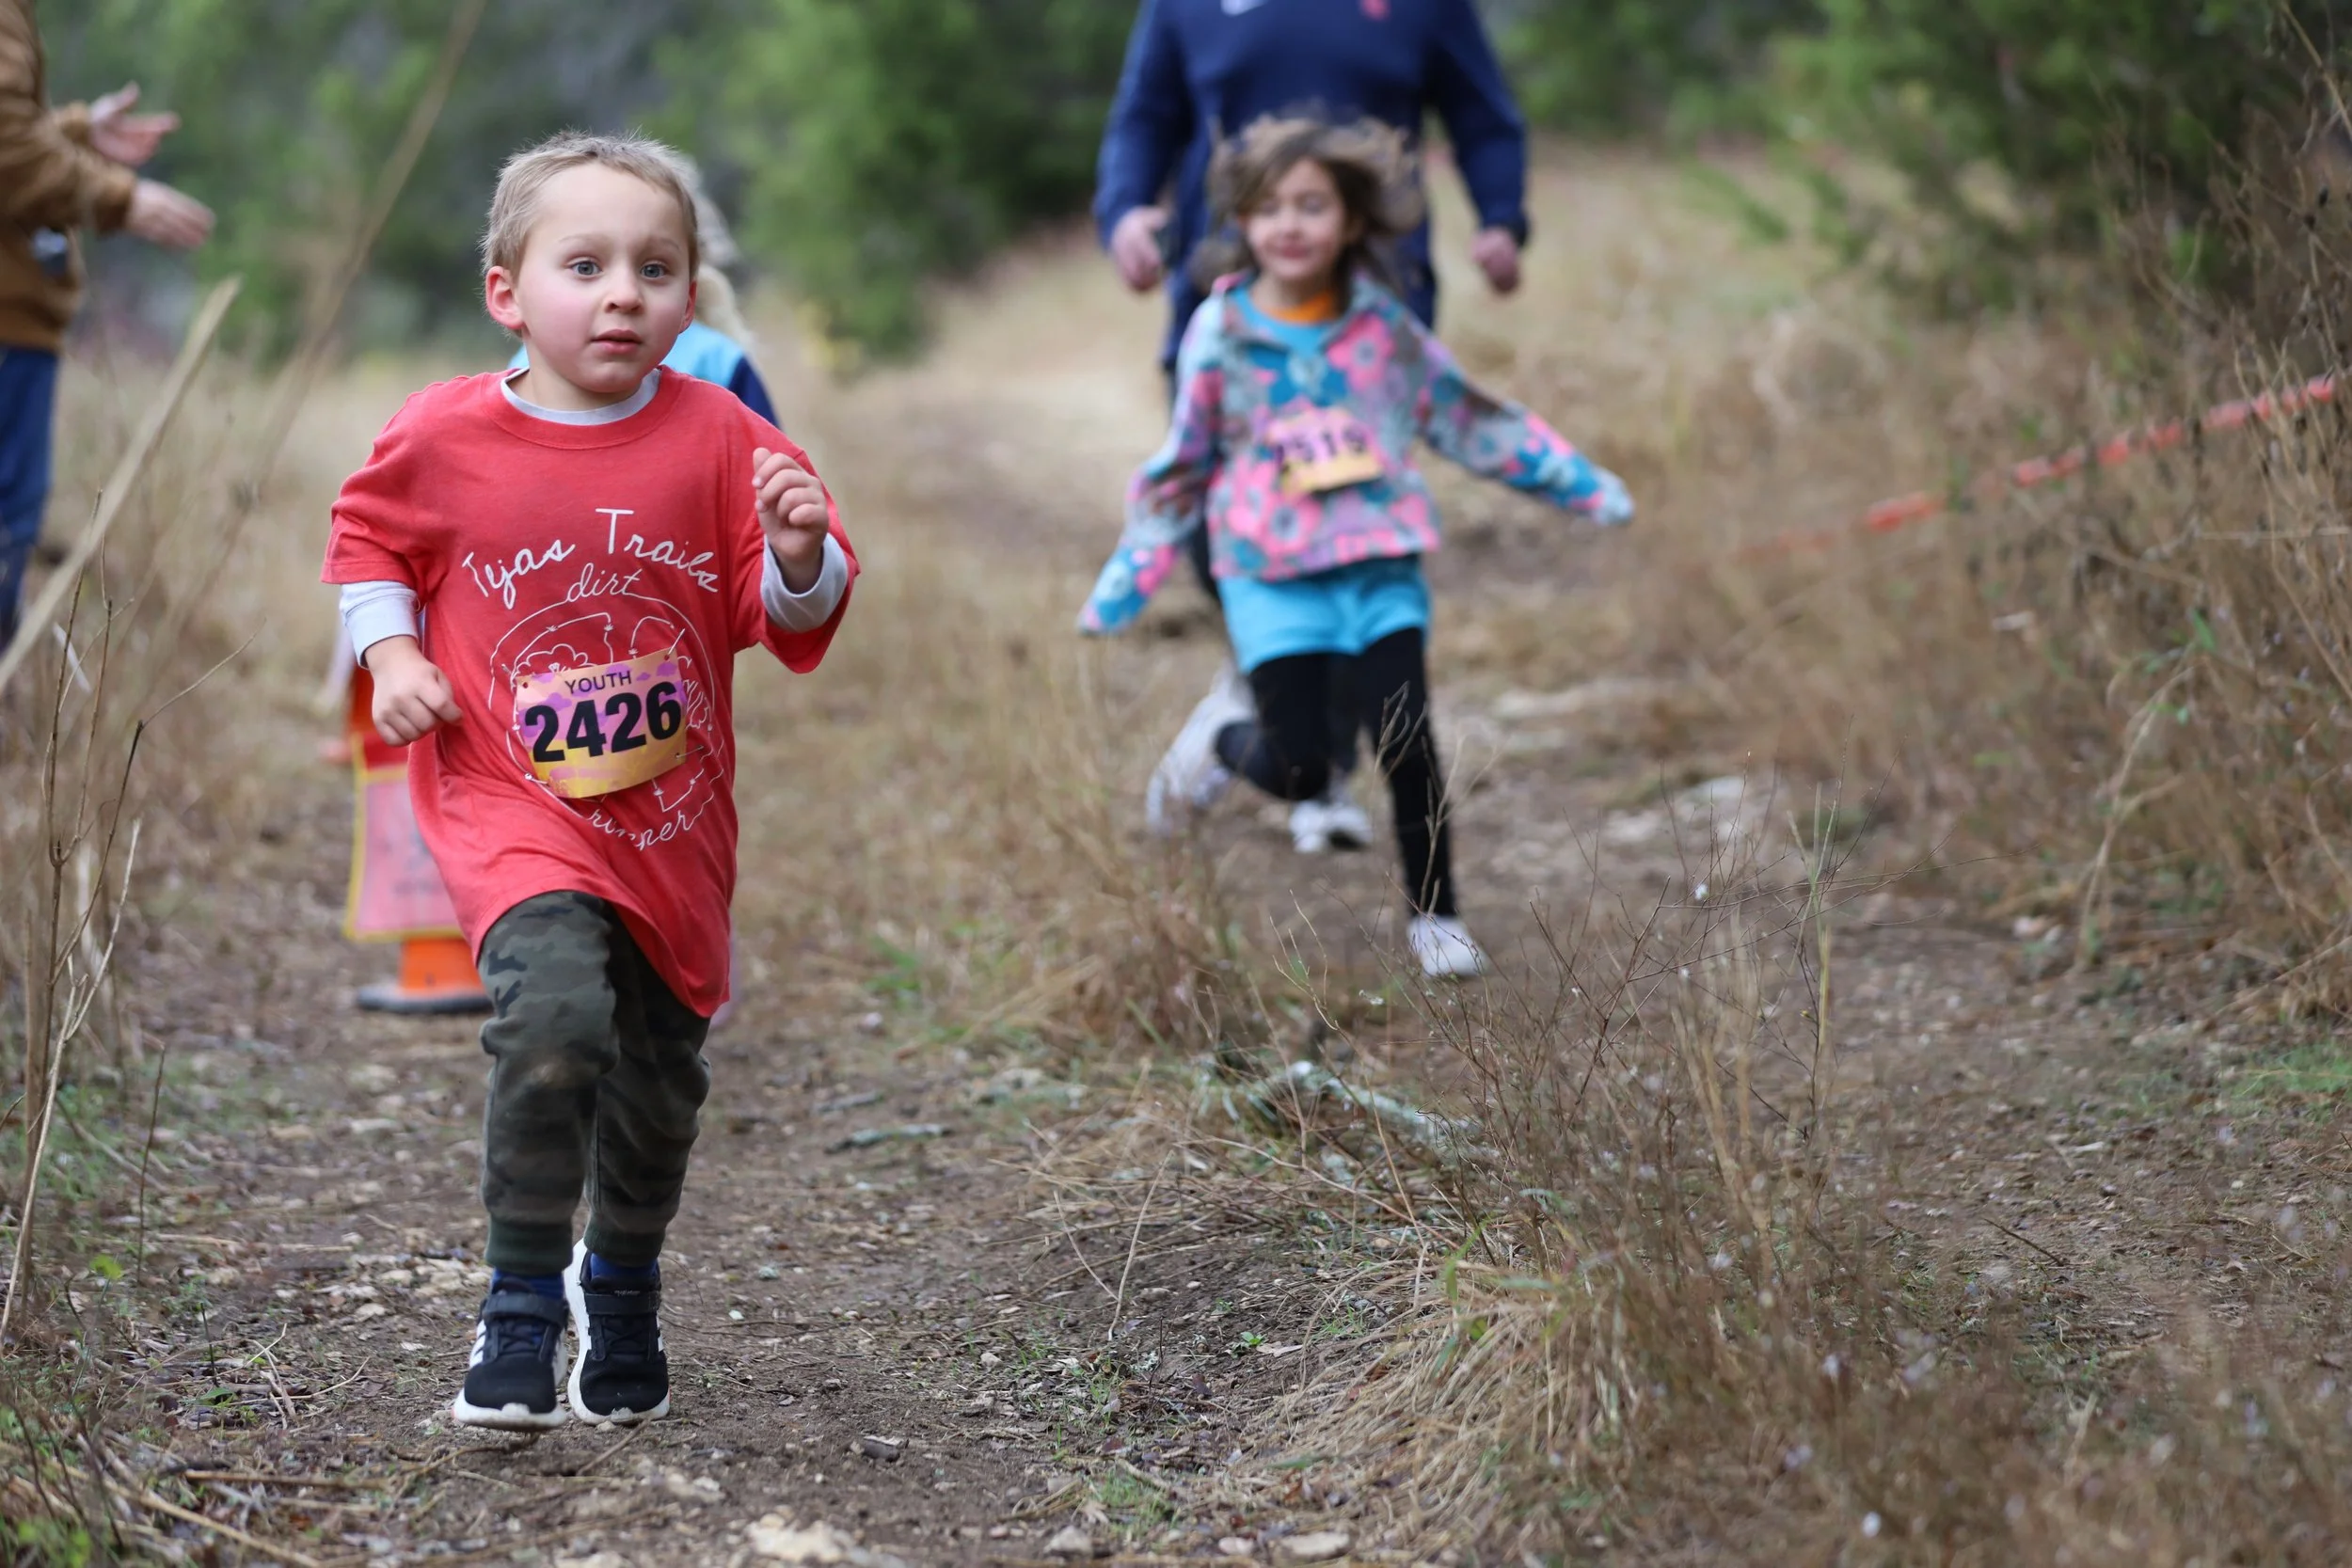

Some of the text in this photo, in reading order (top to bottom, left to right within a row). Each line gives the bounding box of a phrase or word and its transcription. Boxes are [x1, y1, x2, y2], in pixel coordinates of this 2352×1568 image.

[462, 509, 719, 609] Tejas Trails
[568, 563, 643, 602] dirt
[564, 672, 632, 694] YOUTH
[524, 682, 681, 763] 2426
